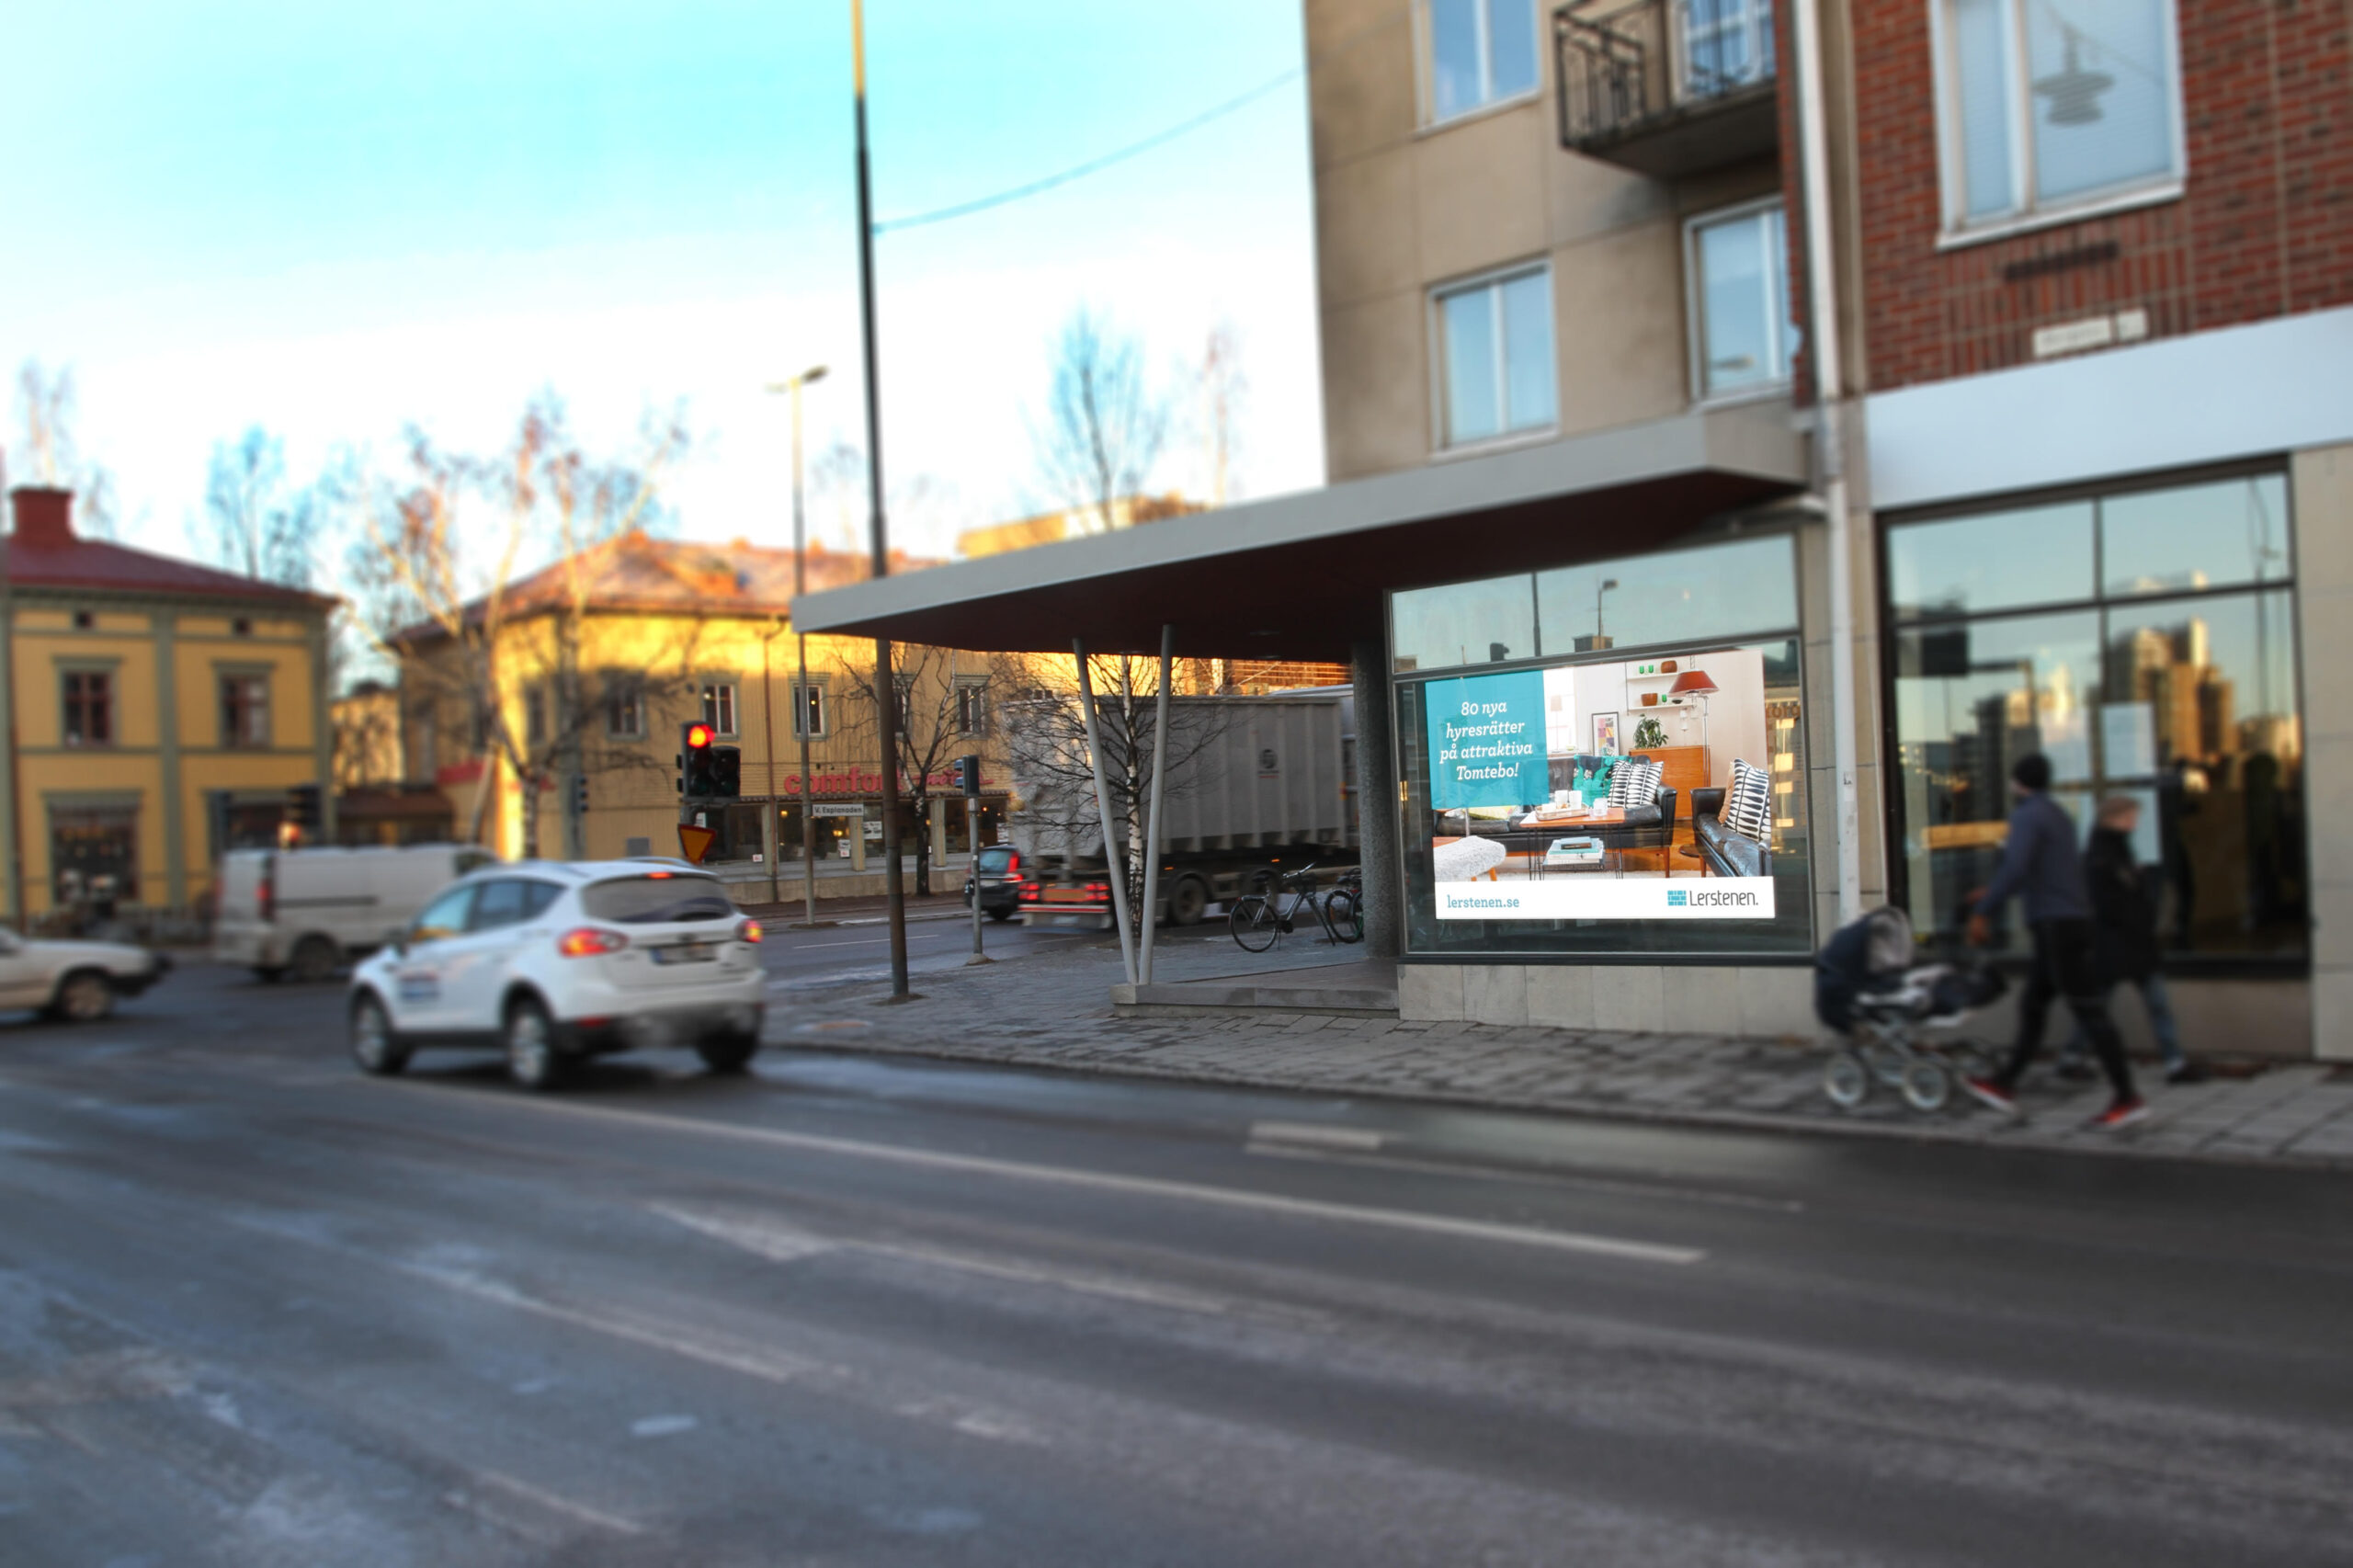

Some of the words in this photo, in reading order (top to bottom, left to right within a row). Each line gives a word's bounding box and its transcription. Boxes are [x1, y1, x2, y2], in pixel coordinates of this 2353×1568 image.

[1461, 701, 1479, 716] 80
[1482, 701, 1507, 718] nya
[1446, 721, 1525, 742] hyresrätter
[1439, 743, 1458, 764] på
[1461, 740, 1533, 759] attraktiva
[784, 767, 905, 794] comfo
[1456, 761, 1519, 780] Tomtebo!
[1447, 894, 1520, 908] lerstenen.se
